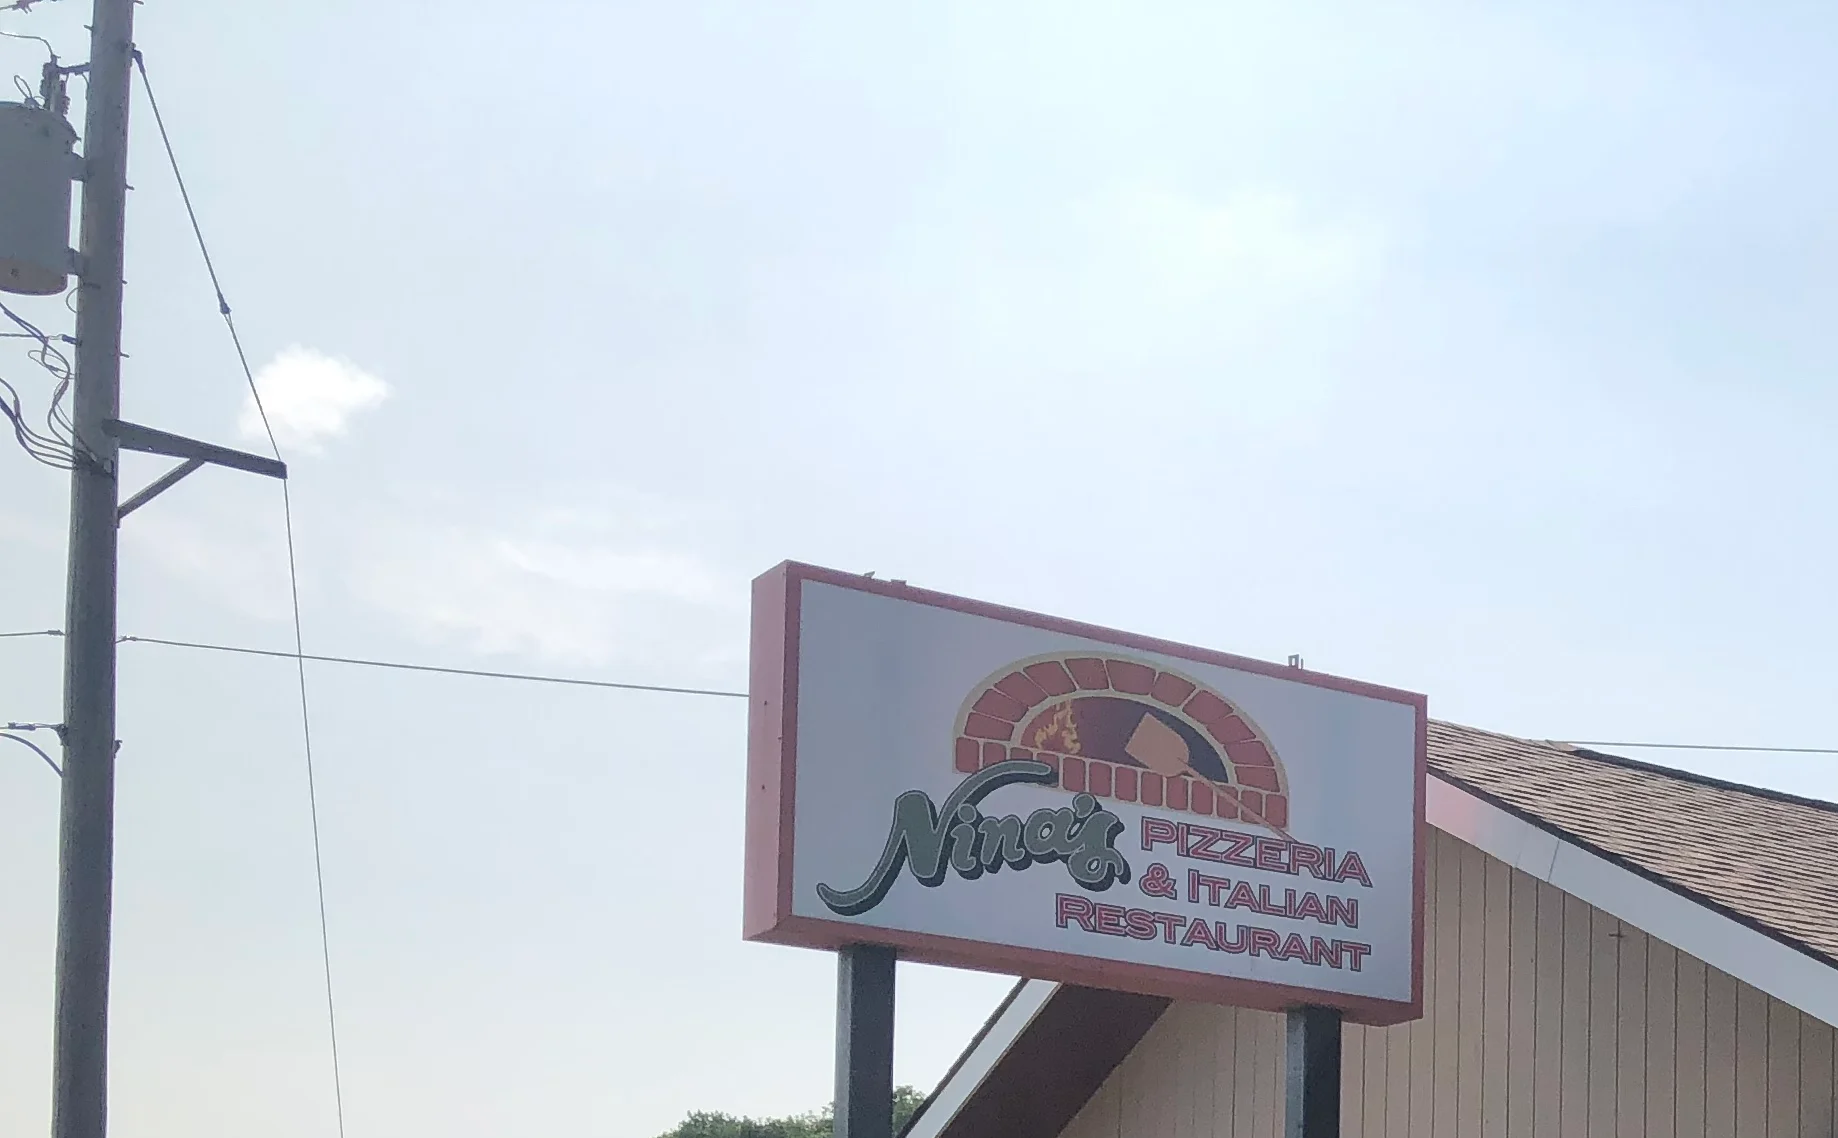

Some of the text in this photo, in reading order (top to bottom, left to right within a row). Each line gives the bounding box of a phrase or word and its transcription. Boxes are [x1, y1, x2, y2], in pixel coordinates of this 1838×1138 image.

[816, 759, 1132, 916] Nina's
[1141, 816, 1373, 888] PIZZERIA
[1055, 892, 1372, 972] RESTAURANT
[1138, 862, 1359, 929] & ITALIAN
